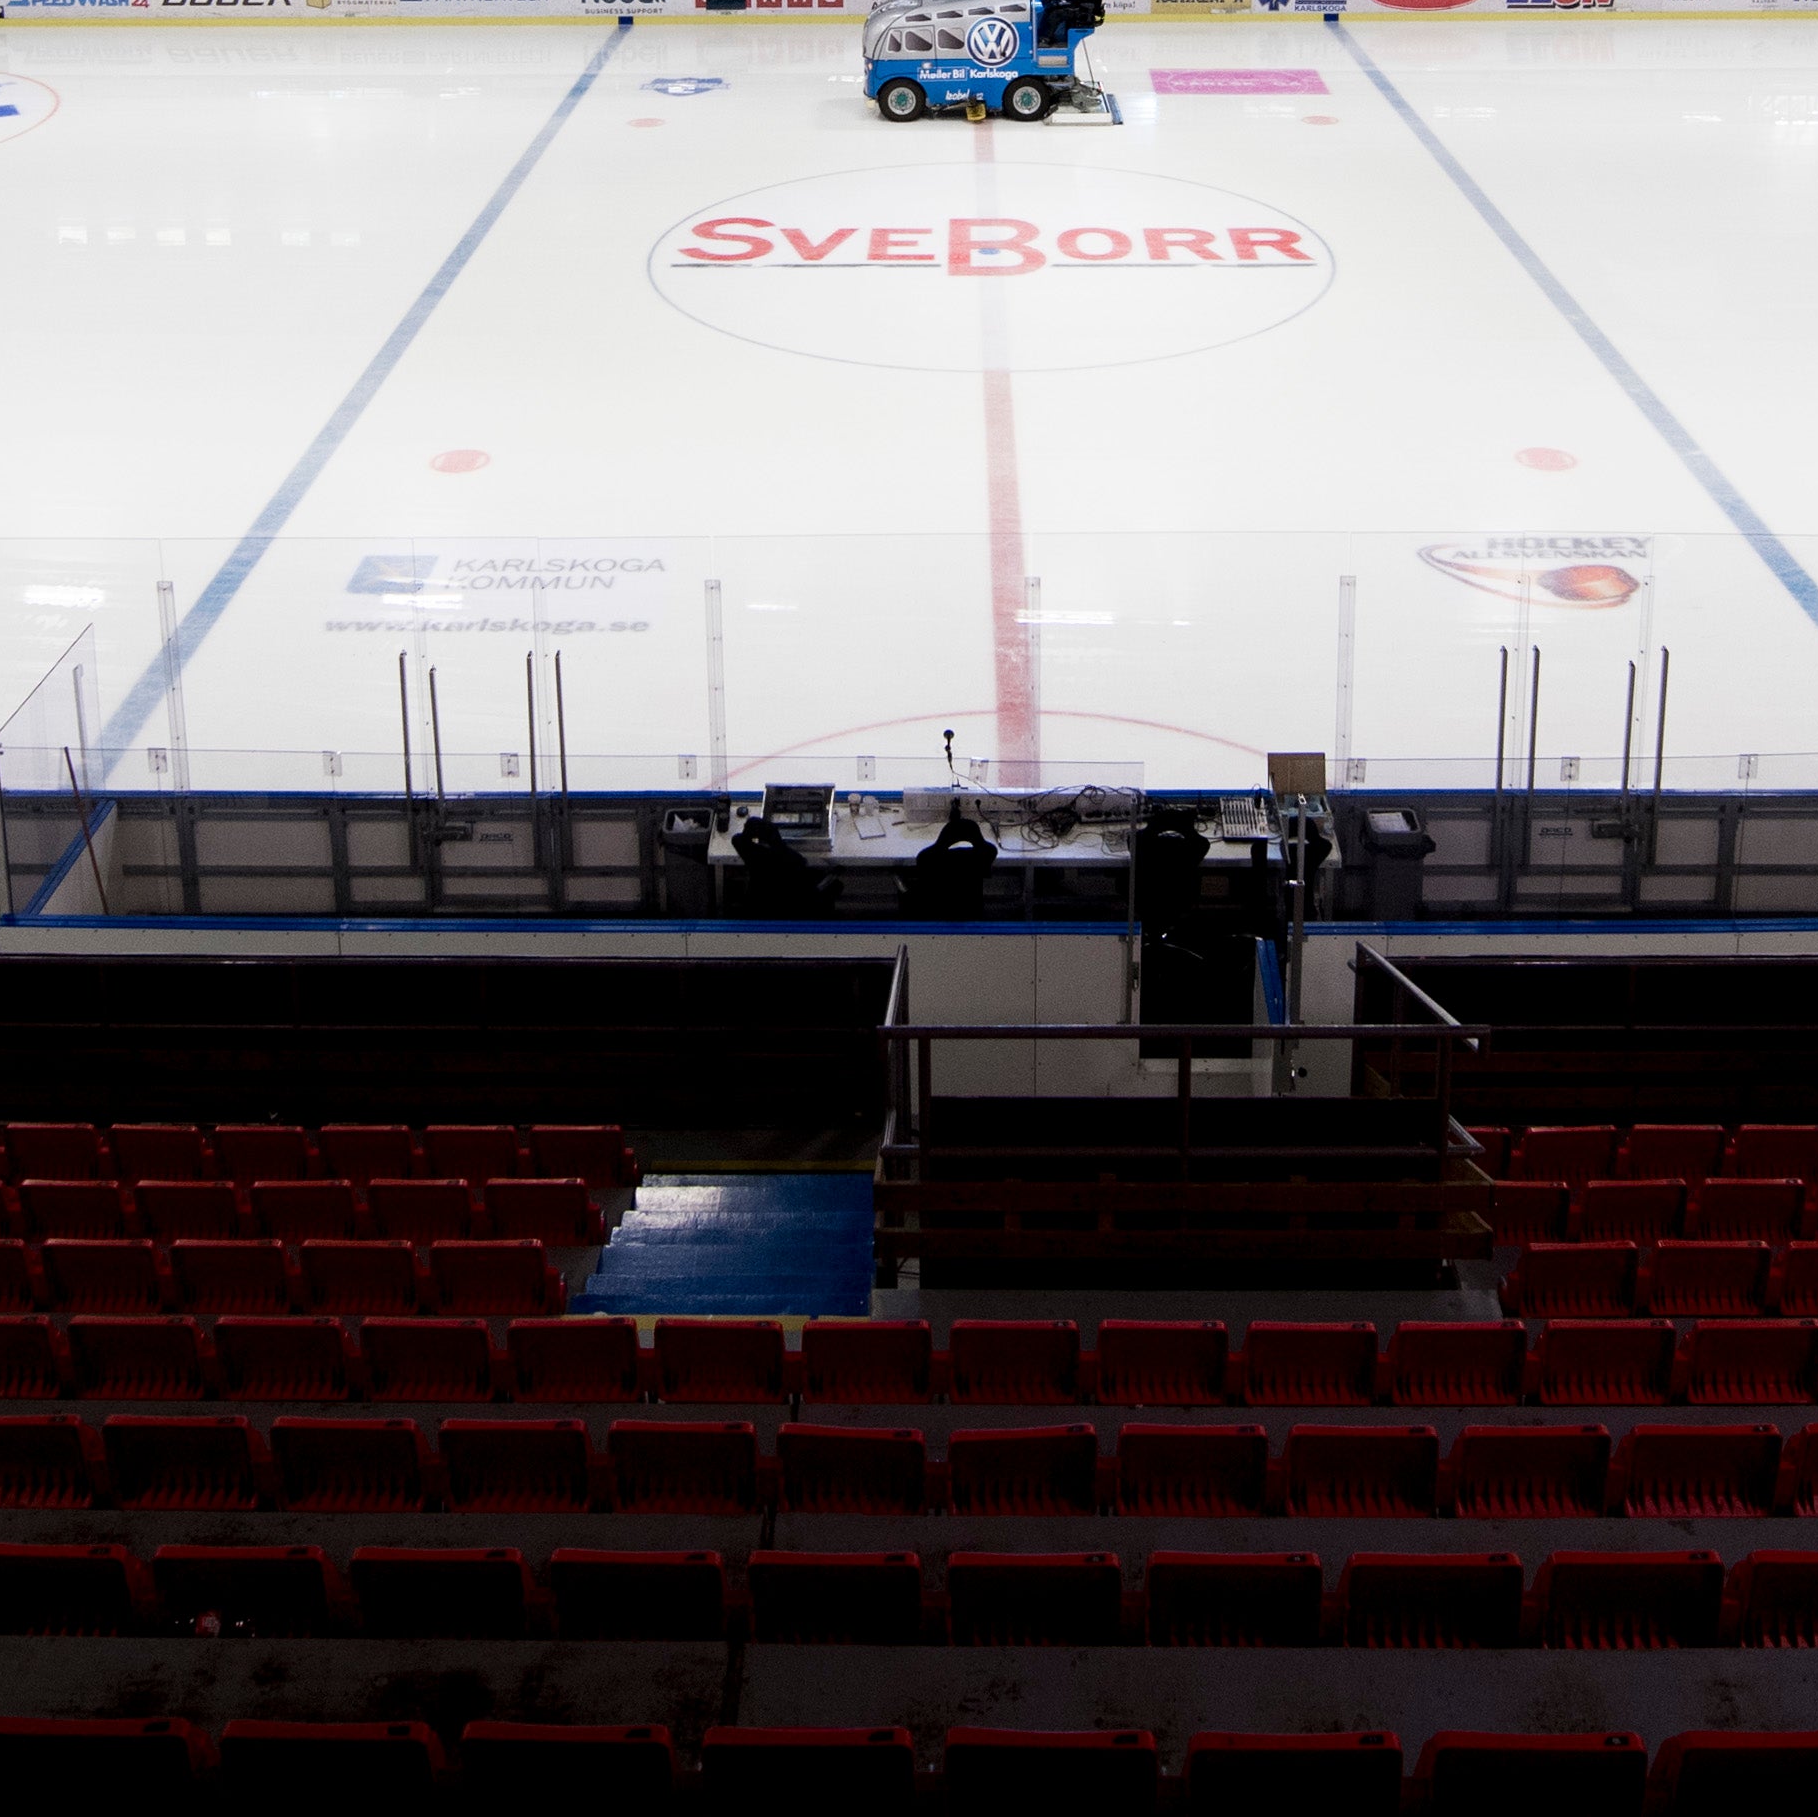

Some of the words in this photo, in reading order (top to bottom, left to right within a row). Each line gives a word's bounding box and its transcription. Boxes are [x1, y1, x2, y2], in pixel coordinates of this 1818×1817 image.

[1294, 4, 1347, 12] KARLSKOGA
[969, 68, 1018, 81] Karlskoga
[1486, 537, 1654, 551] HOCKEY
[1453, 549, 1649, 559] ALLSVENSKAN
[452, 557, 667, 573] KARLSKOGA
[445, 575, 615, 590] KOMMUN
[323, 616, 652, 635] www.karlskoga.se
